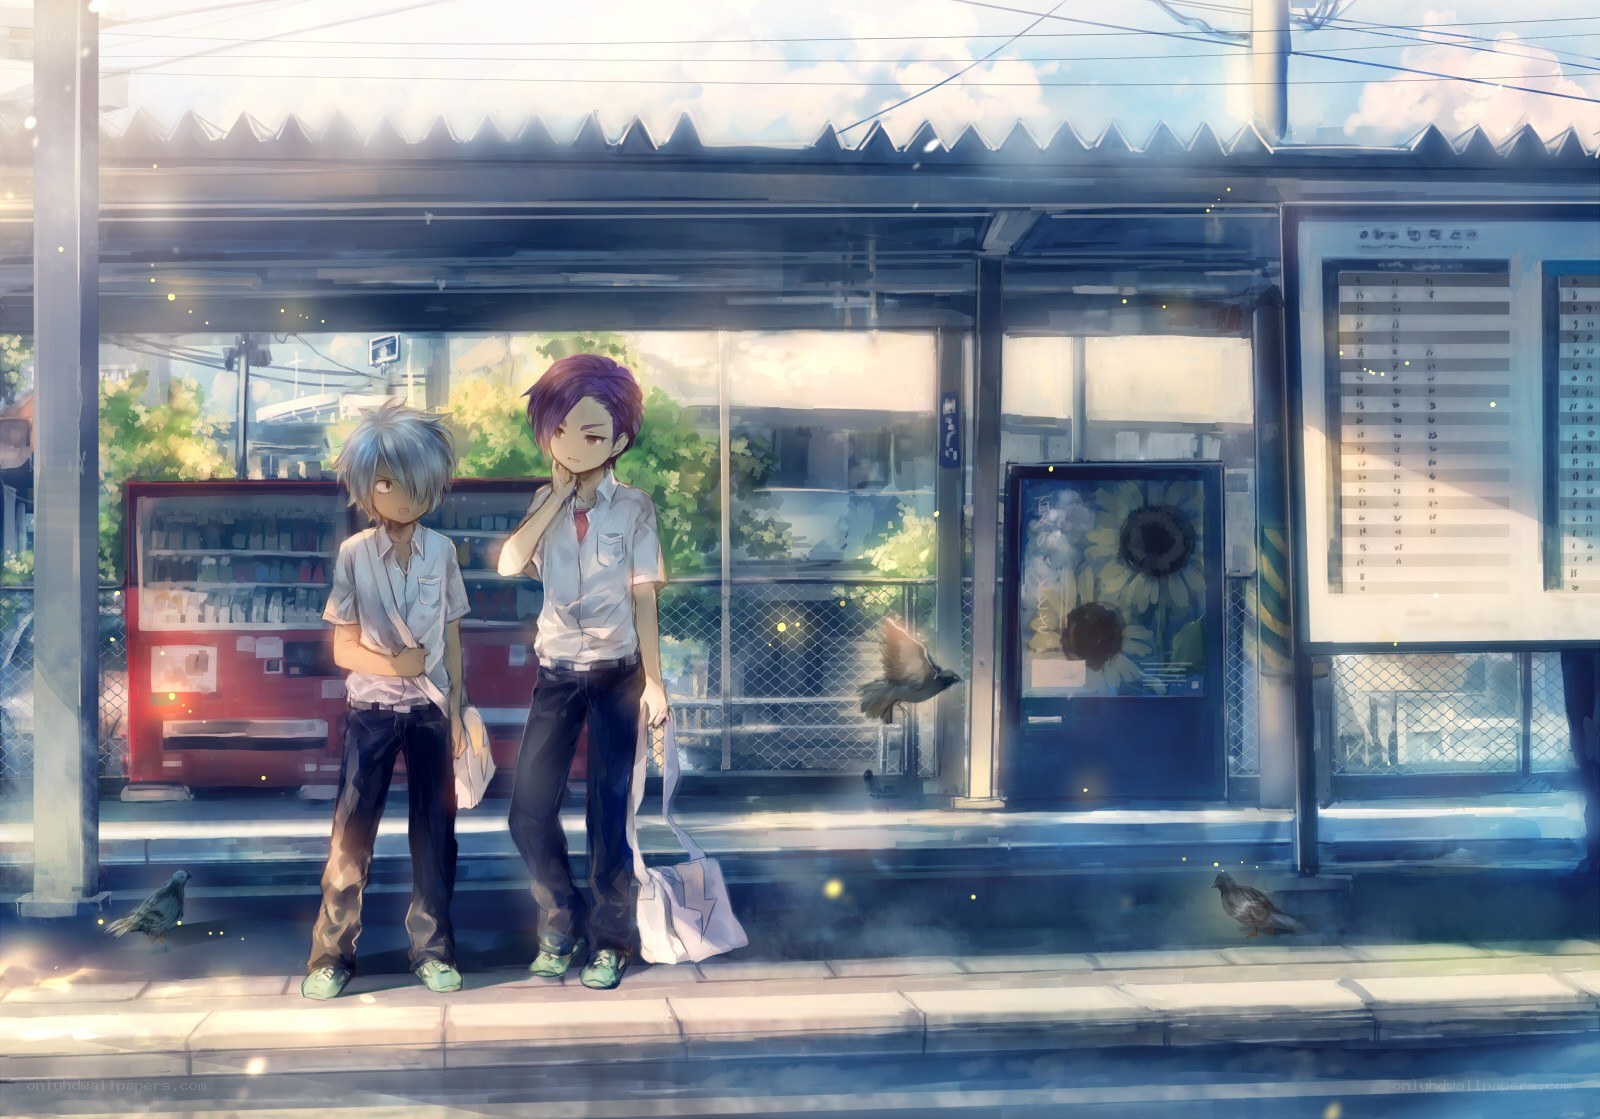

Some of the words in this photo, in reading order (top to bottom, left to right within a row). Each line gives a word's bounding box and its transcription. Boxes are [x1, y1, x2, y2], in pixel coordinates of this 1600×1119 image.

[1034, 495, 1053, 634] 夏のひととき
